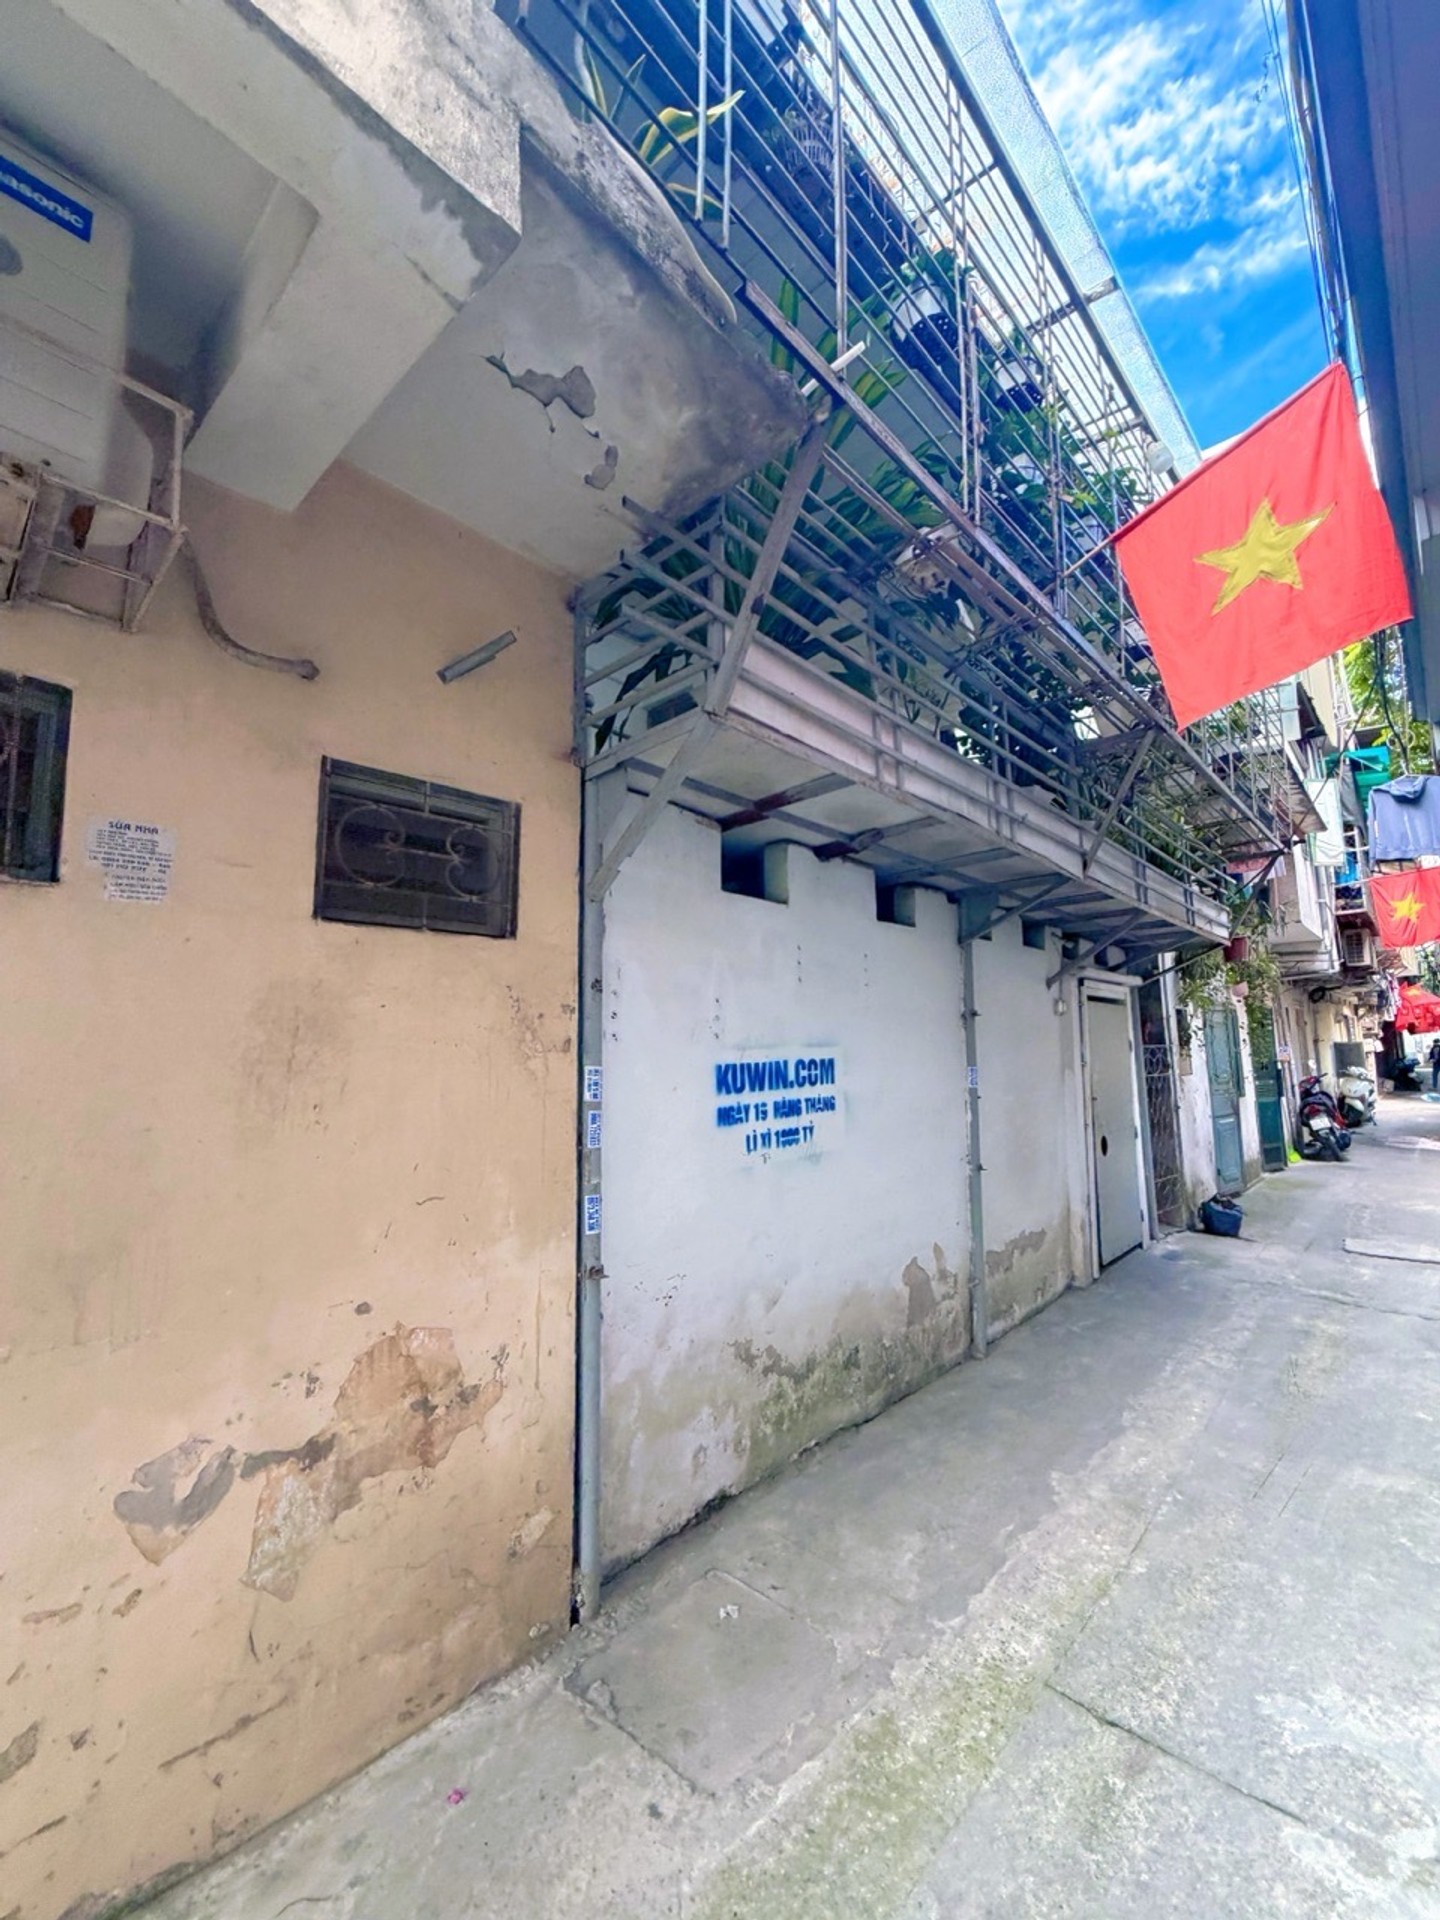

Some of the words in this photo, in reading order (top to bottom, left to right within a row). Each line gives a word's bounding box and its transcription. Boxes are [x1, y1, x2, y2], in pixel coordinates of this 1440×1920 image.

[715, 1057, 836, 1096] KUWIN.COM
[716, 1102, 751, 1128] NGÀY
[773, 1096, 802, 1119] HÀNG
[804, 1094, 836, 1114] THÁNG
